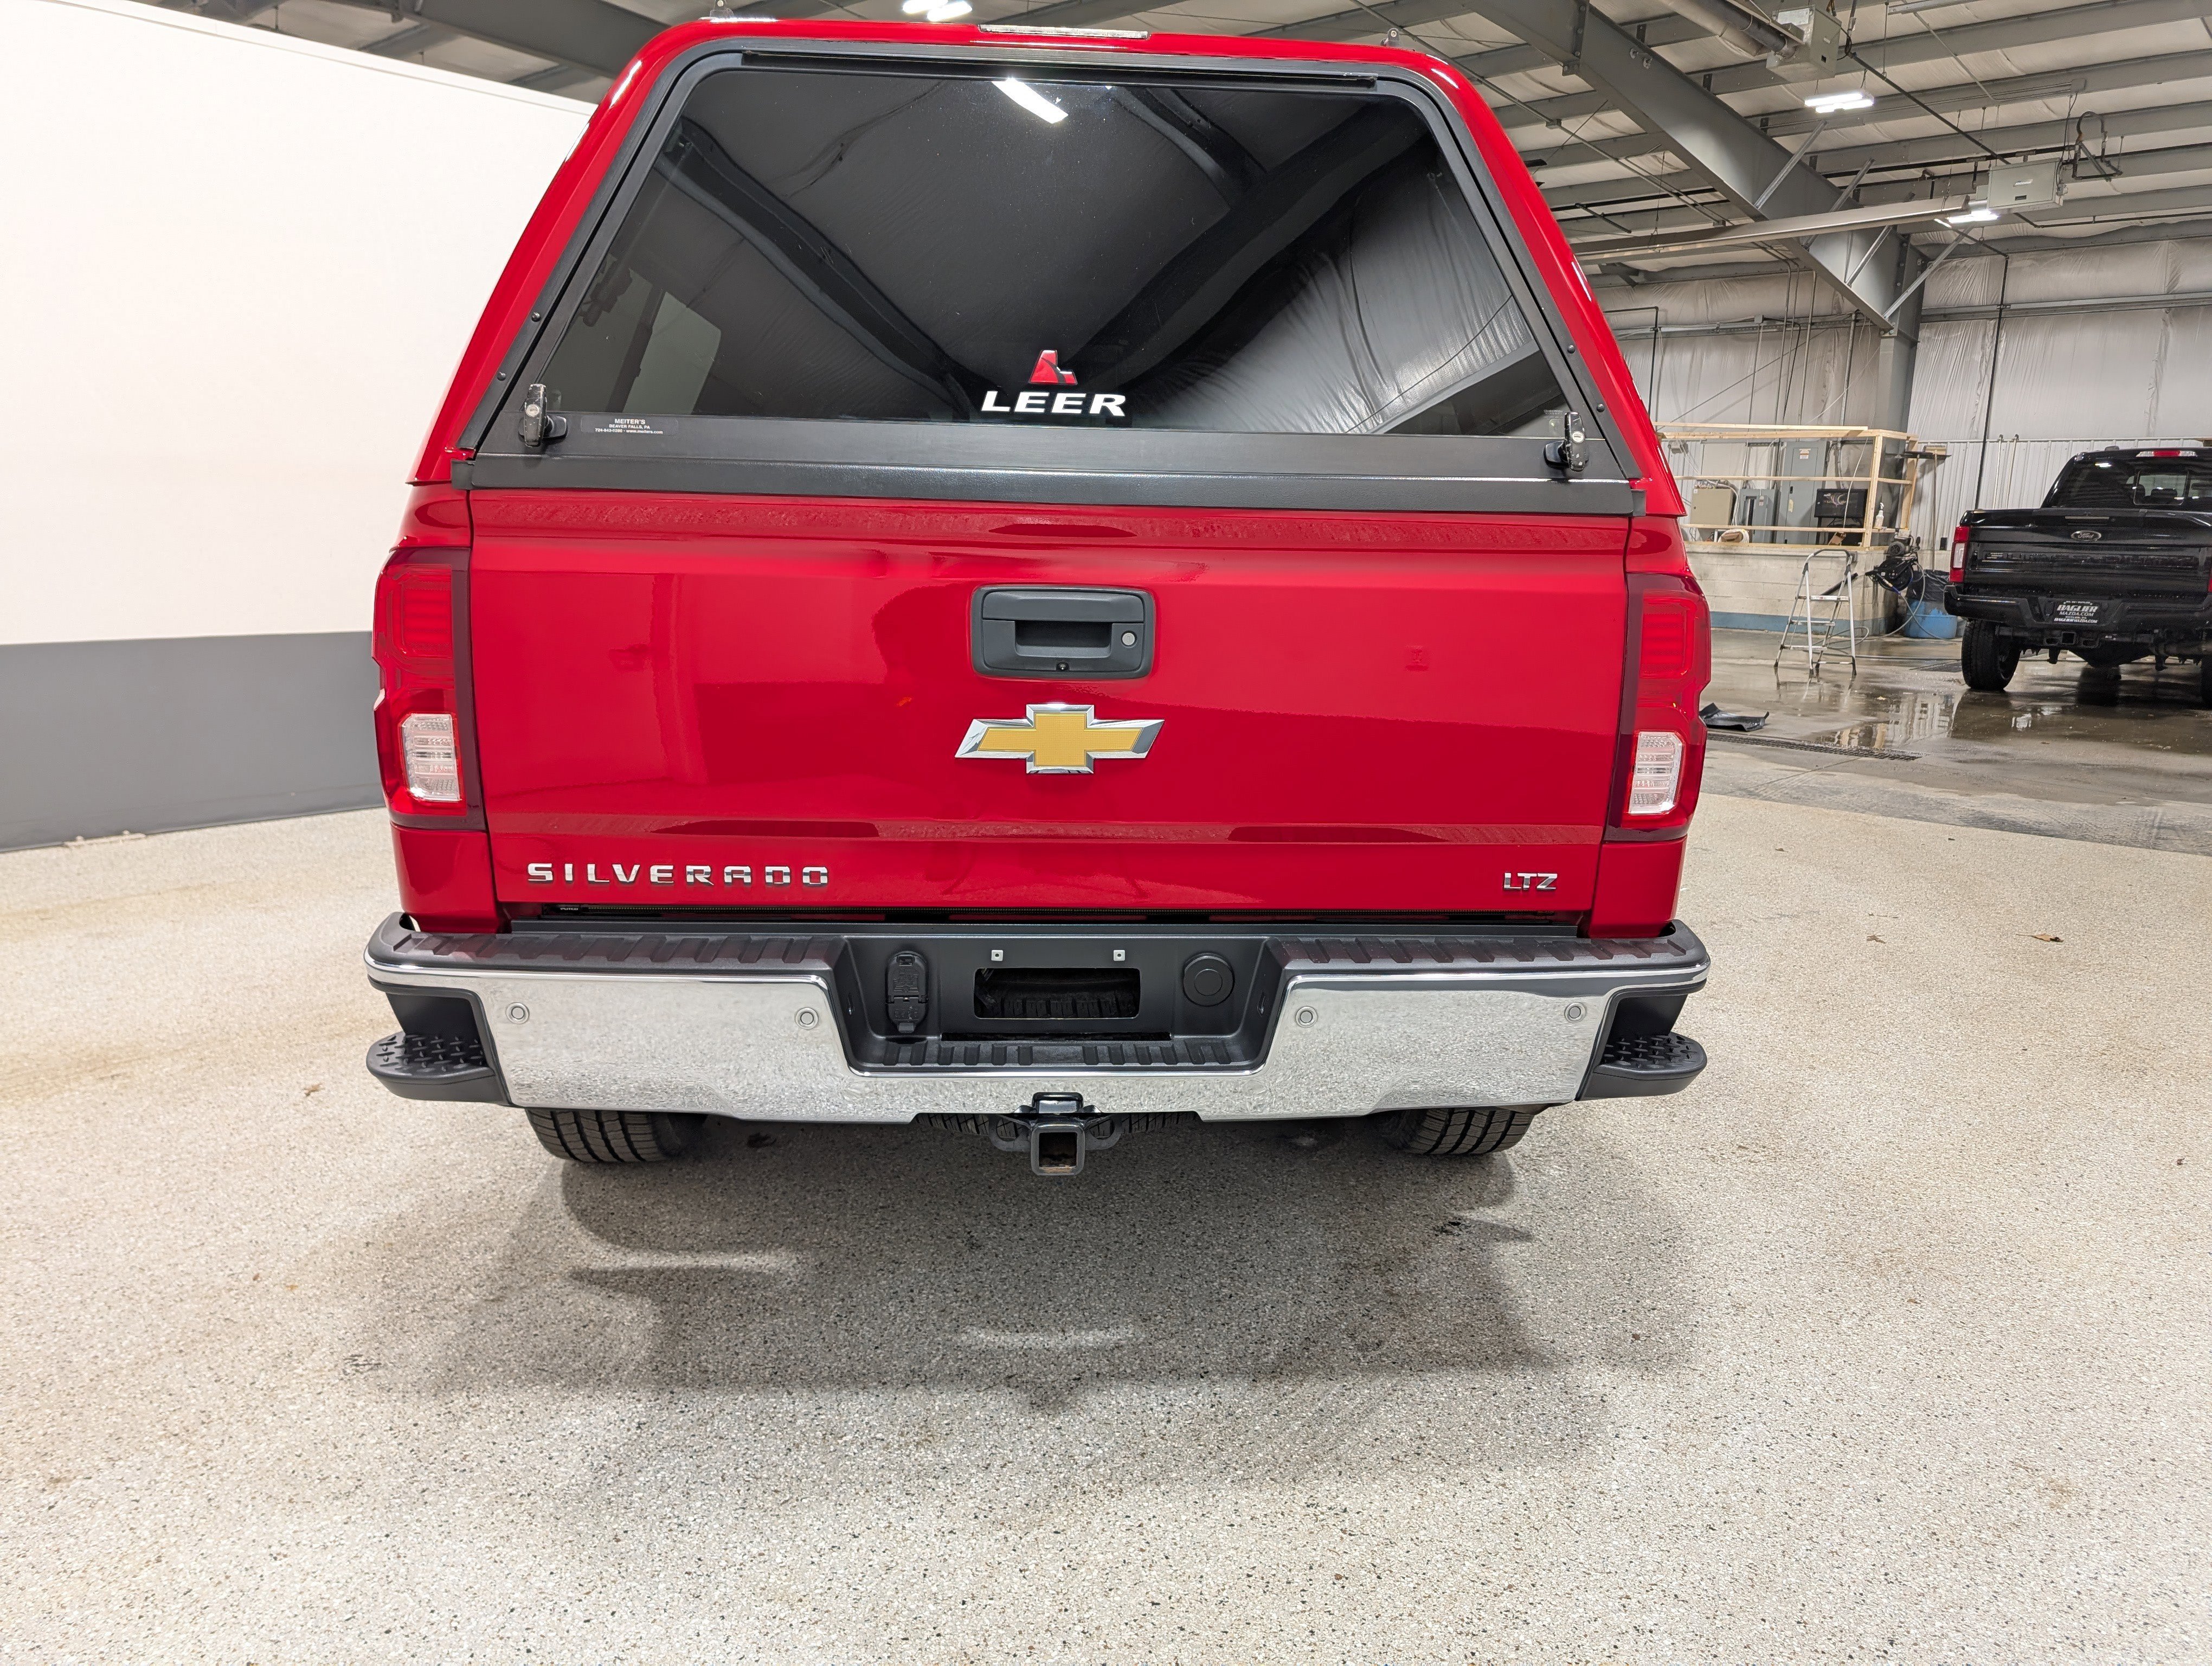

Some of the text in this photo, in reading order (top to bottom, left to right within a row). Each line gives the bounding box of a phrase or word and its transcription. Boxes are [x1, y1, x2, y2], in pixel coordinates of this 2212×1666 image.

[981, 390, 1126, 416] LEER
[2056, 604, 2098, 613] BAGLIER
[527, 862, 829, 887] SILVERADO
[1503, 872, 1558, 890] LTZ
